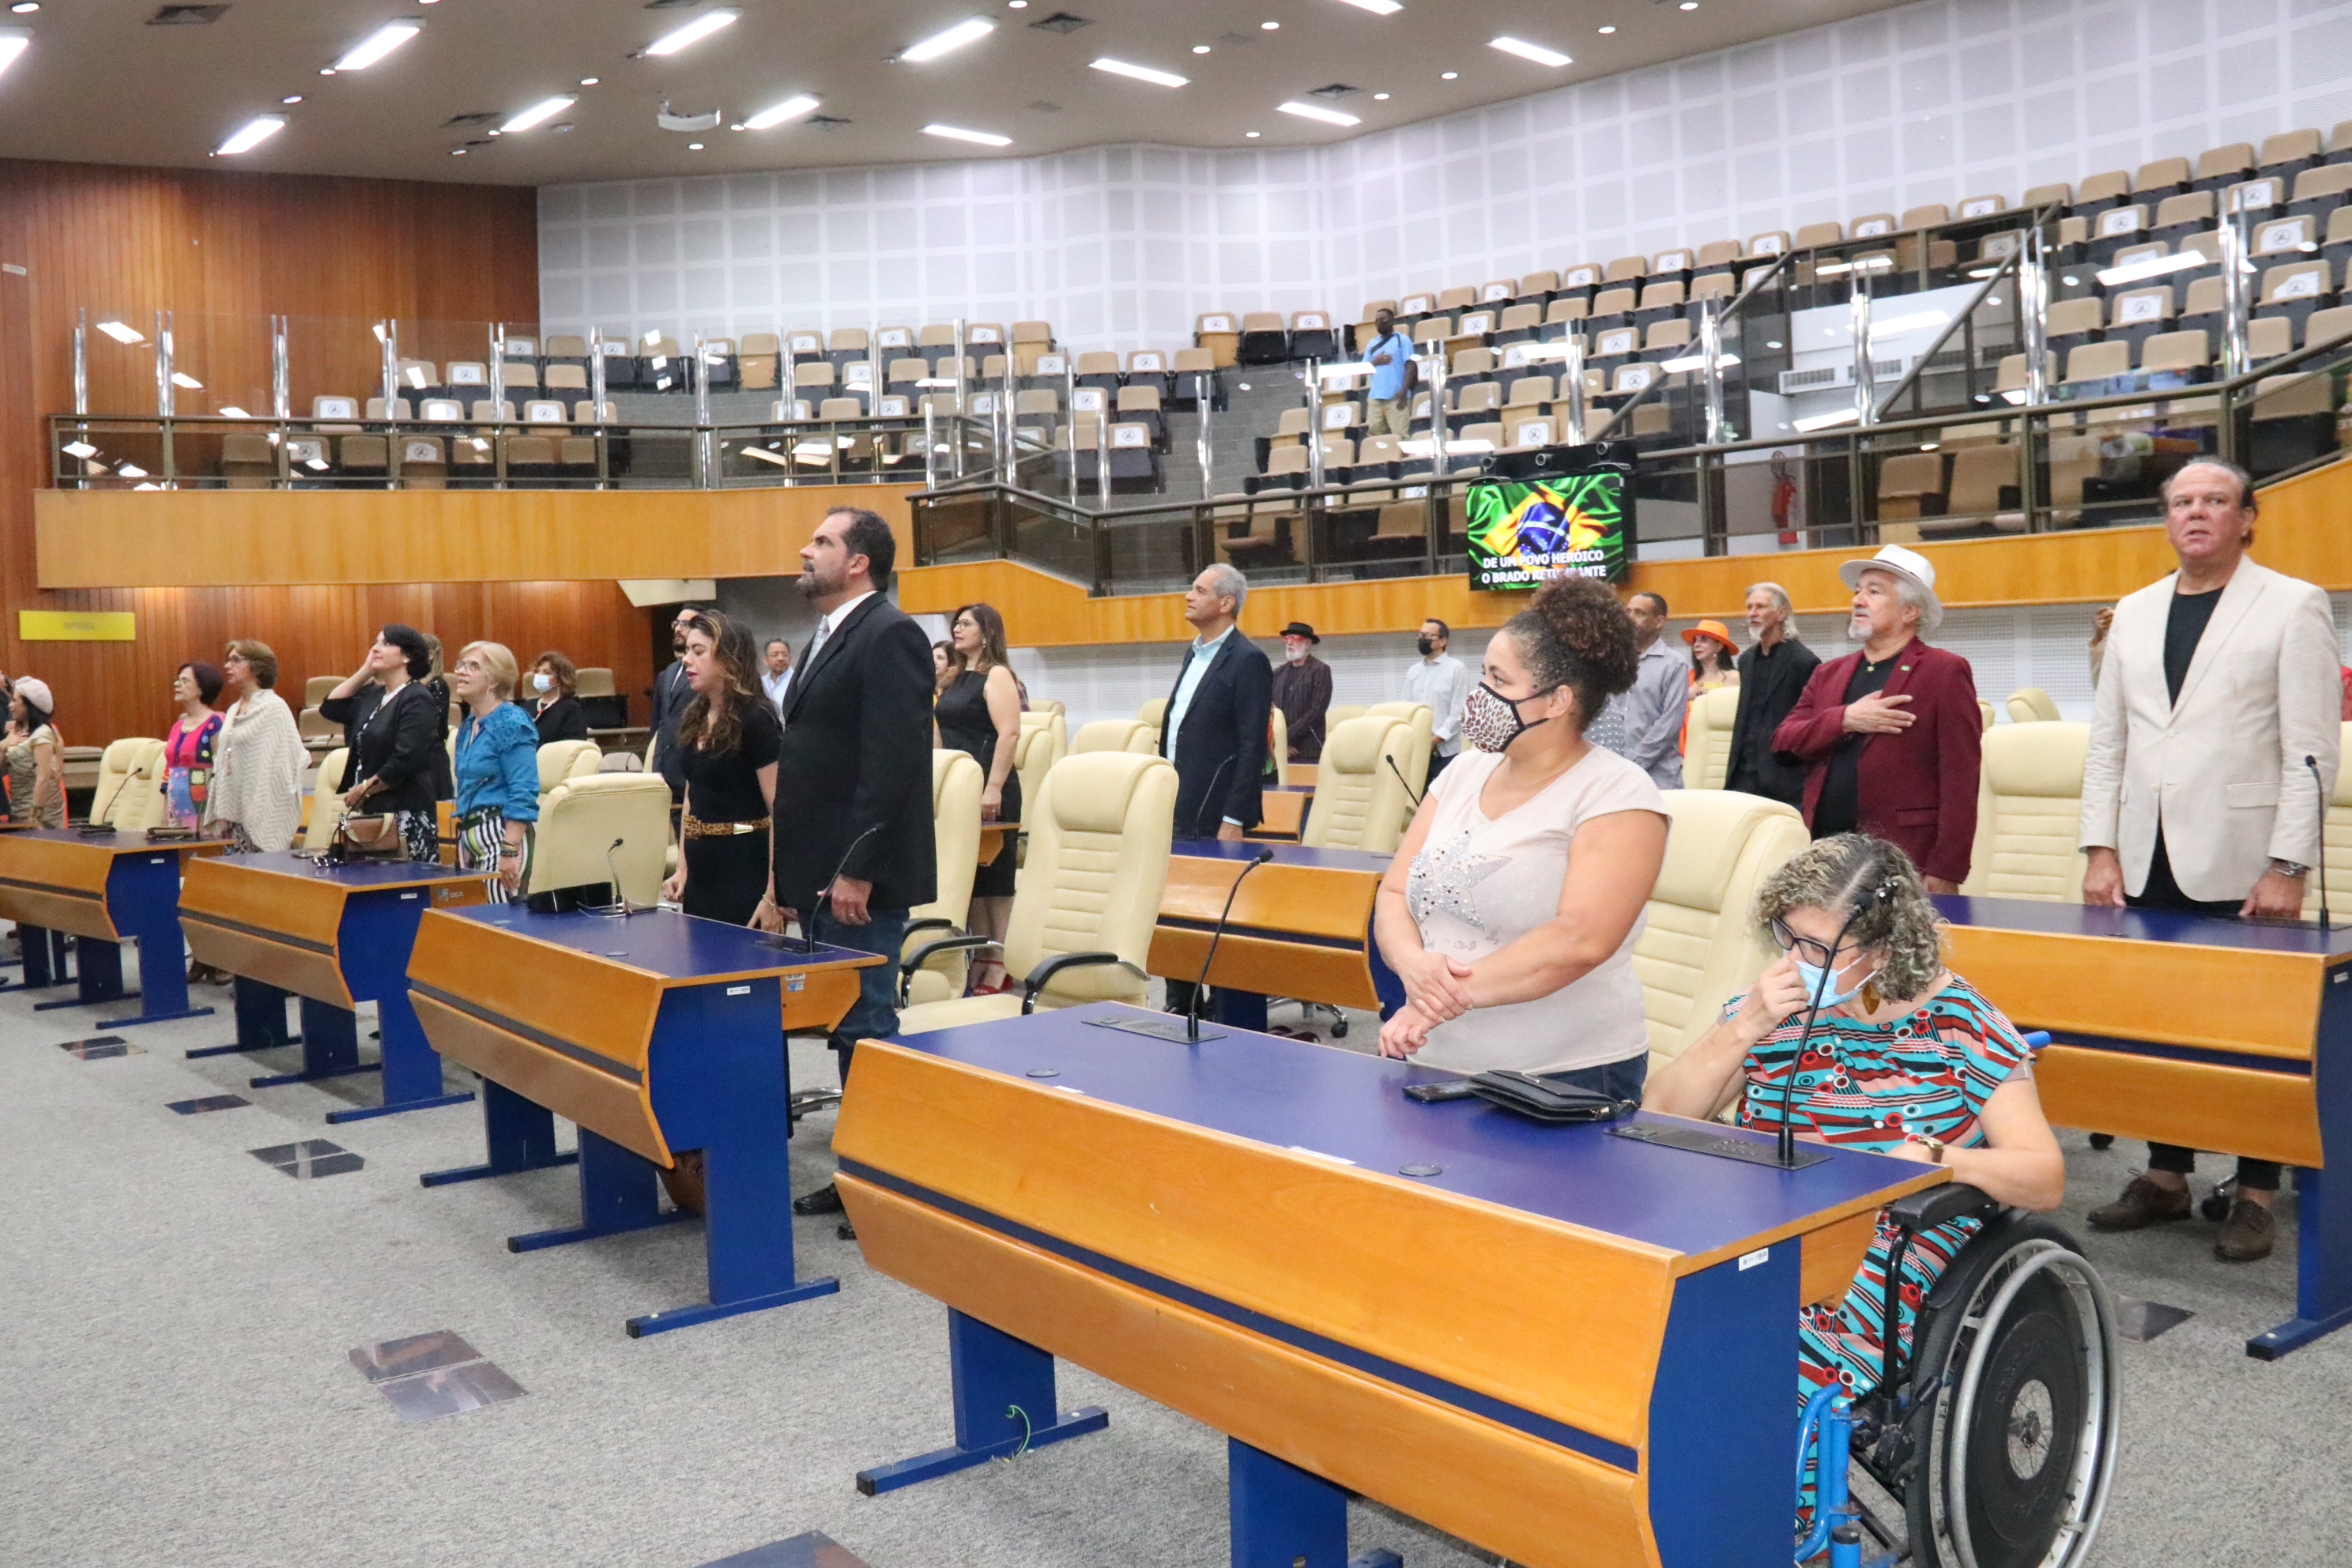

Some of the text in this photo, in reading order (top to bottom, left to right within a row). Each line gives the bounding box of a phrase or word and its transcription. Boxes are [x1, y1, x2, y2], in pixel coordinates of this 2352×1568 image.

[1483, 549, 1604, 569] DE UM POVO HERÓICO
[1481, 573, 1491, 584] O
[1492, 571, 1530, 583] BRADO
